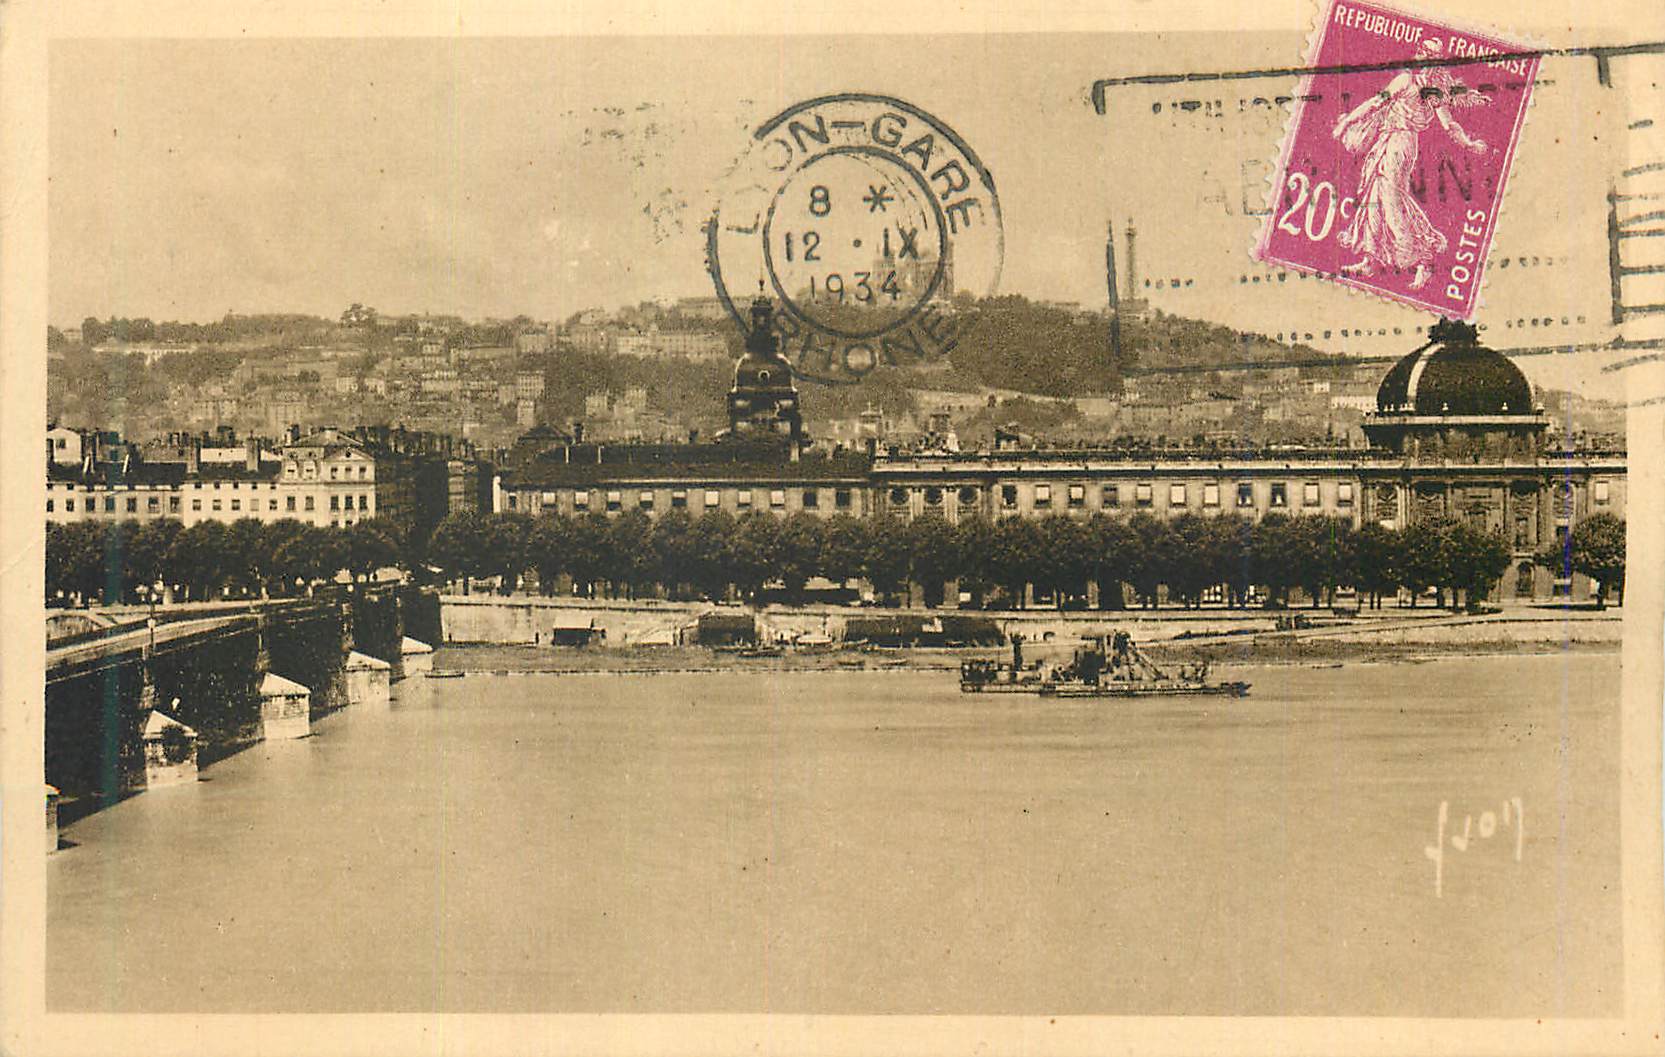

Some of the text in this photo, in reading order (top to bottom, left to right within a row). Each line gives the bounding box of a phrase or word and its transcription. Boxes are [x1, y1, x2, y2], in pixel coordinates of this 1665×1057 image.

[1334, 4, 1424, 45] REPUBLIQUE
[725, 112, 981, 235] LON-GARE
[808, 185, 831, 217] 8
[785, 227, 919, 262] 12 IX
[1446, 208, 1486, 301] POSTES
[810, 271, 901, 302] 1934
